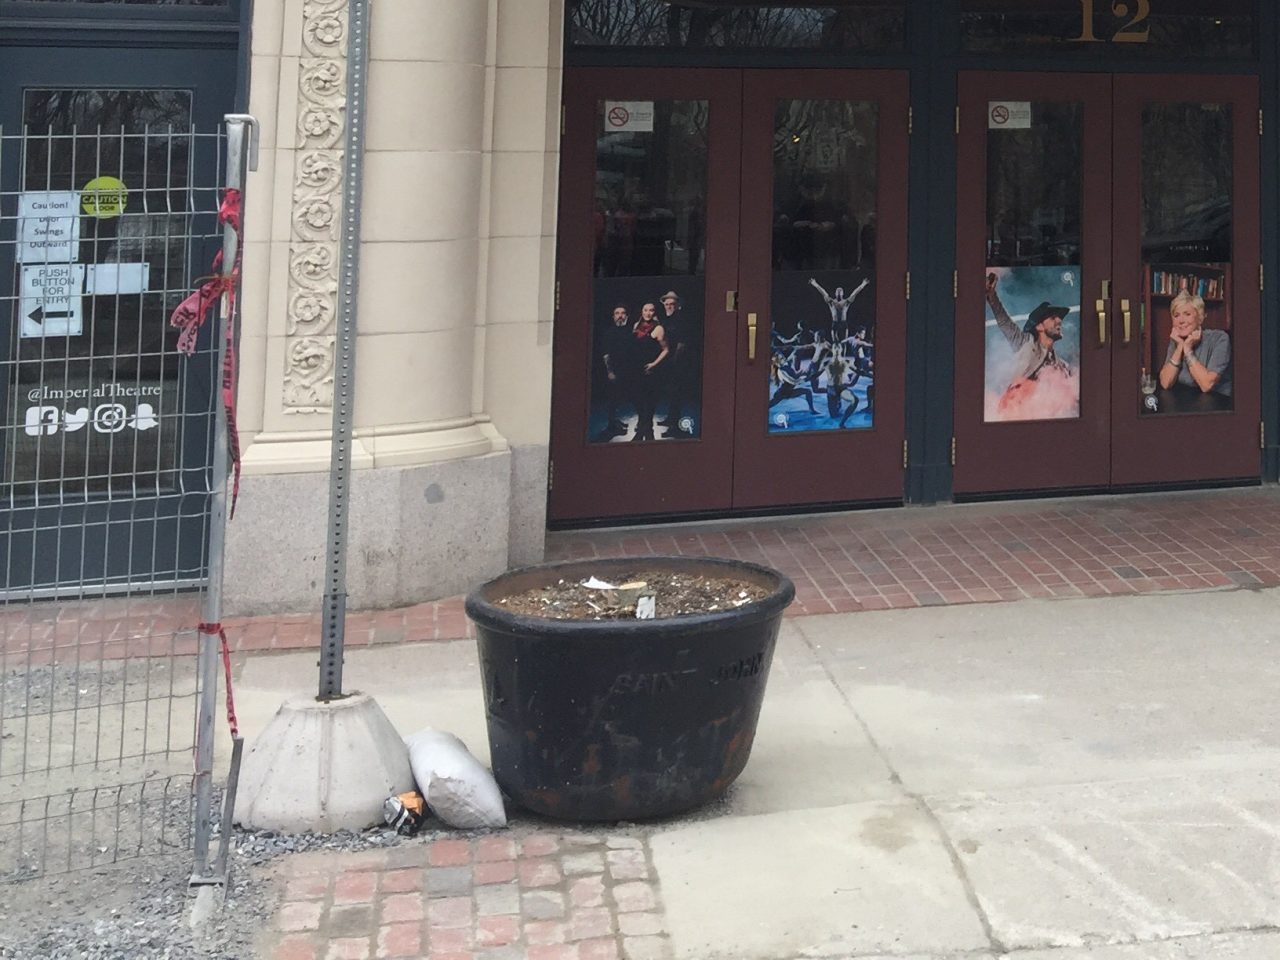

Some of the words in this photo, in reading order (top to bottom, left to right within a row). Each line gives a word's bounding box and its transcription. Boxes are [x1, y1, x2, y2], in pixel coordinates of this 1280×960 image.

[82, 195, 128, 204] CAUTION
[34, 228, 64, 236] Swngs
[39, 268, 69, 277] PUSH
[42, 286, 64, 295] FOR
[27, 382, 161, 402] @ImperalTheatre
